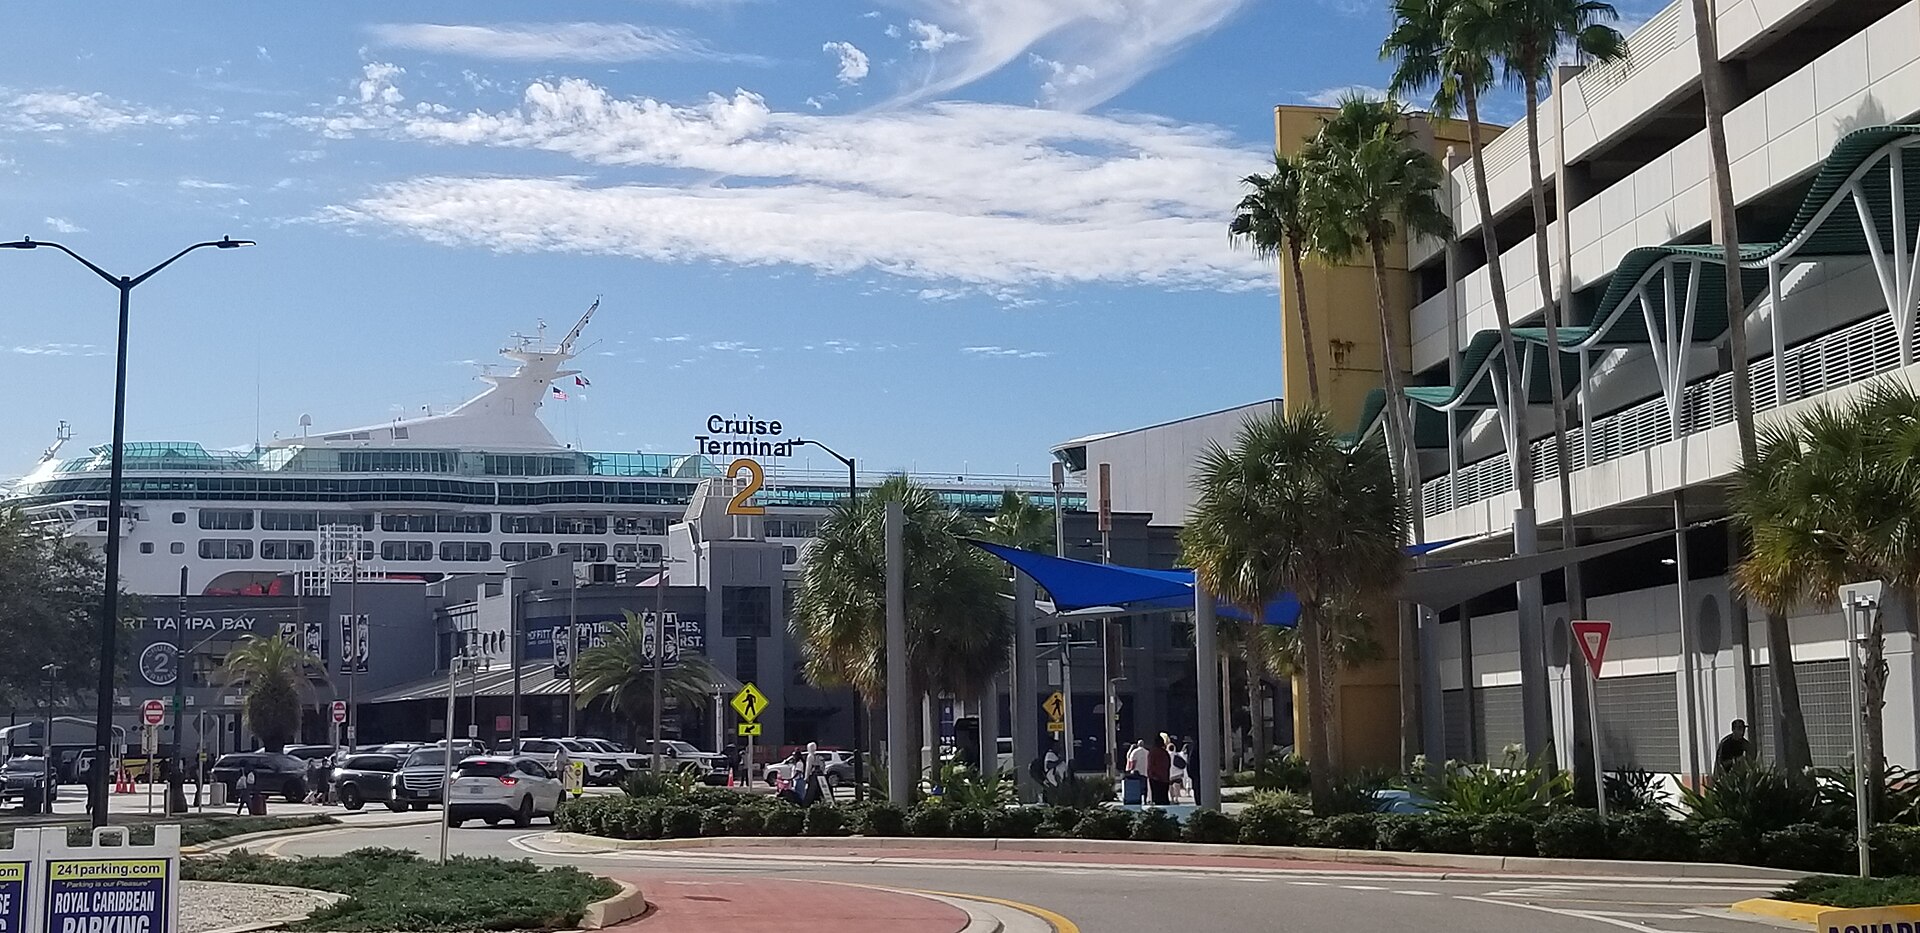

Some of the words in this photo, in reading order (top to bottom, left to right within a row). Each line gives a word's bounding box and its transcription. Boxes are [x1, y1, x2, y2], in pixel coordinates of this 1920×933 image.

[707, 414, 783, 436] Cruise
[695, 436, 792, 457] Terminal
[726, 458, 766, 515] 2
[123, 617, 147, 630] RT
[222, 617, 256, 630] BAY
[680, 635, 704, 647] RST.
[154, 653, 169, 673] 2
[57, 863, 161, 878] 241parking.com
[103, 880, 115, 888] our
[54, 892, 91, 914] ROYAL
[92, 890, 156, 913] CARIBBEAN
[62, 915, 151, 933] PARKING
